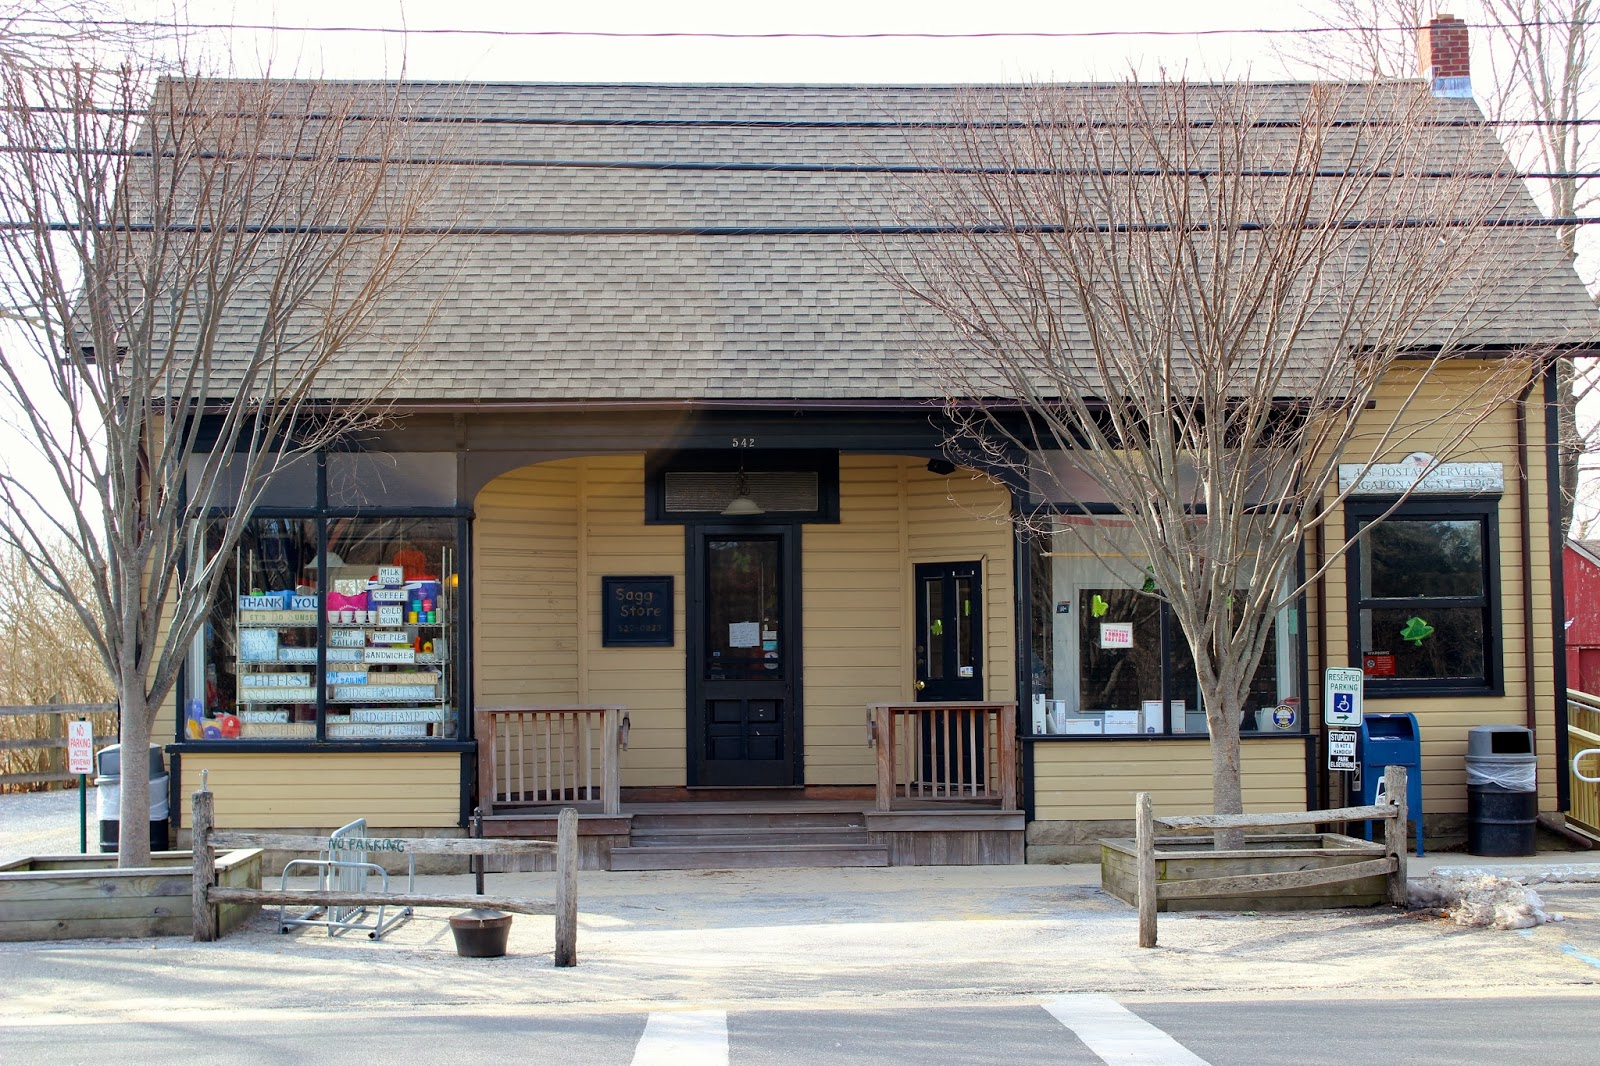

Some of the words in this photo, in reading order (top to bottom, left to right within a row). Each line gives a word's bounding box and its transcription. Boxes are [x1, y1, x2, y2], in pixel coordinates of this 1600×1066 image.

[732, 438, 755, 448] 542
[1434, 467, 1483, 477] SERVICE
[1437, 479, 1452, 489] NY
[380, 568, 400, 576] MILK
[381, 576, 400, 584] EGGS
[374, 591, 405, 599] COFFEE
[615, 588, 654, 606] Sagg
[242, 597, 282, 608] THANK
[295, 598, 318, 608] YOU
[381, 606, 402, 615] COLD
[620, 604, 662, 617] Store
[380, 617, 401, 625] DRINK
[332, 630, 353, 638] GONE
[332, 639, 364, 647] SAILING
[365, 651, 414, 660] SANDWICHES
[242, 674, 308, 687] CHEERS!
[340, 676, 368, 685] SAILING
[1328, 673, 1360, 682] RESERVED
[1330, 682, 1358, 691] PARKING
[336, 686, 422, 698] BRIDGEHAMPTON
[353, 711, 442, 722] BRIDGEHAMPTON
[76, 726, 84, 737] NO
[1330, 733, 1355, 742] STUPIDITY
[70, 738, 91, 749] PARKING
[70, 758, 91, 766] DRIVEWAY
[328, 838, 344, 850] NO
[348, 838, 405, 853] PARKING
